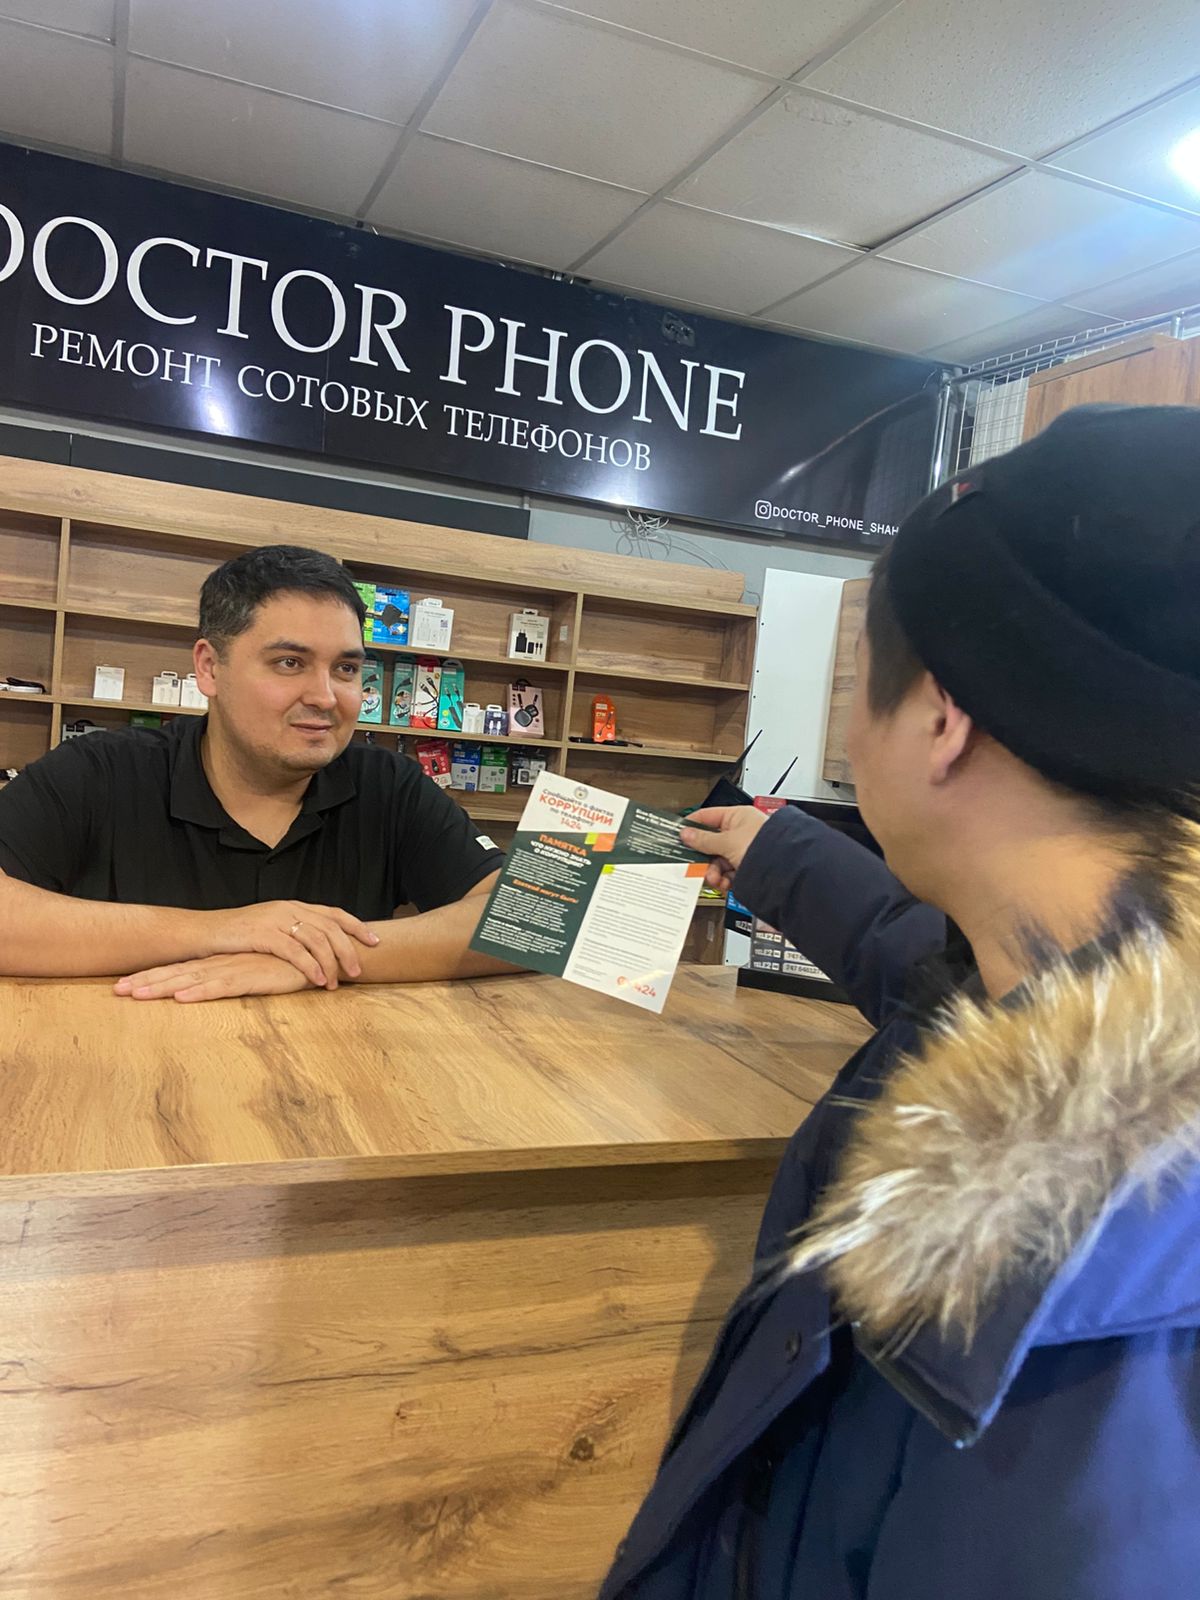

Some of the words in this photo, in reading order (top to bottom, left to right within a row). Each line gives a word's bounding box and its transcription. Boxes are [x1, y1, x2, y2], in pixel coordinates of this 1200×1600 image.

[439, 304, 746, 441] PHONE
[30, 322, 221, 389] РЕМОНТ
[237, 365, 429, 430] СОТОВЫХ
[443, 405, 651, 472] ТЕЛЕФОНОВ
[539, 793, 614, 827] КОРРУПЦИИ
[560, 817, 582, 830] 1424
[539, 833, 588, 857] ПАМЯТКА
